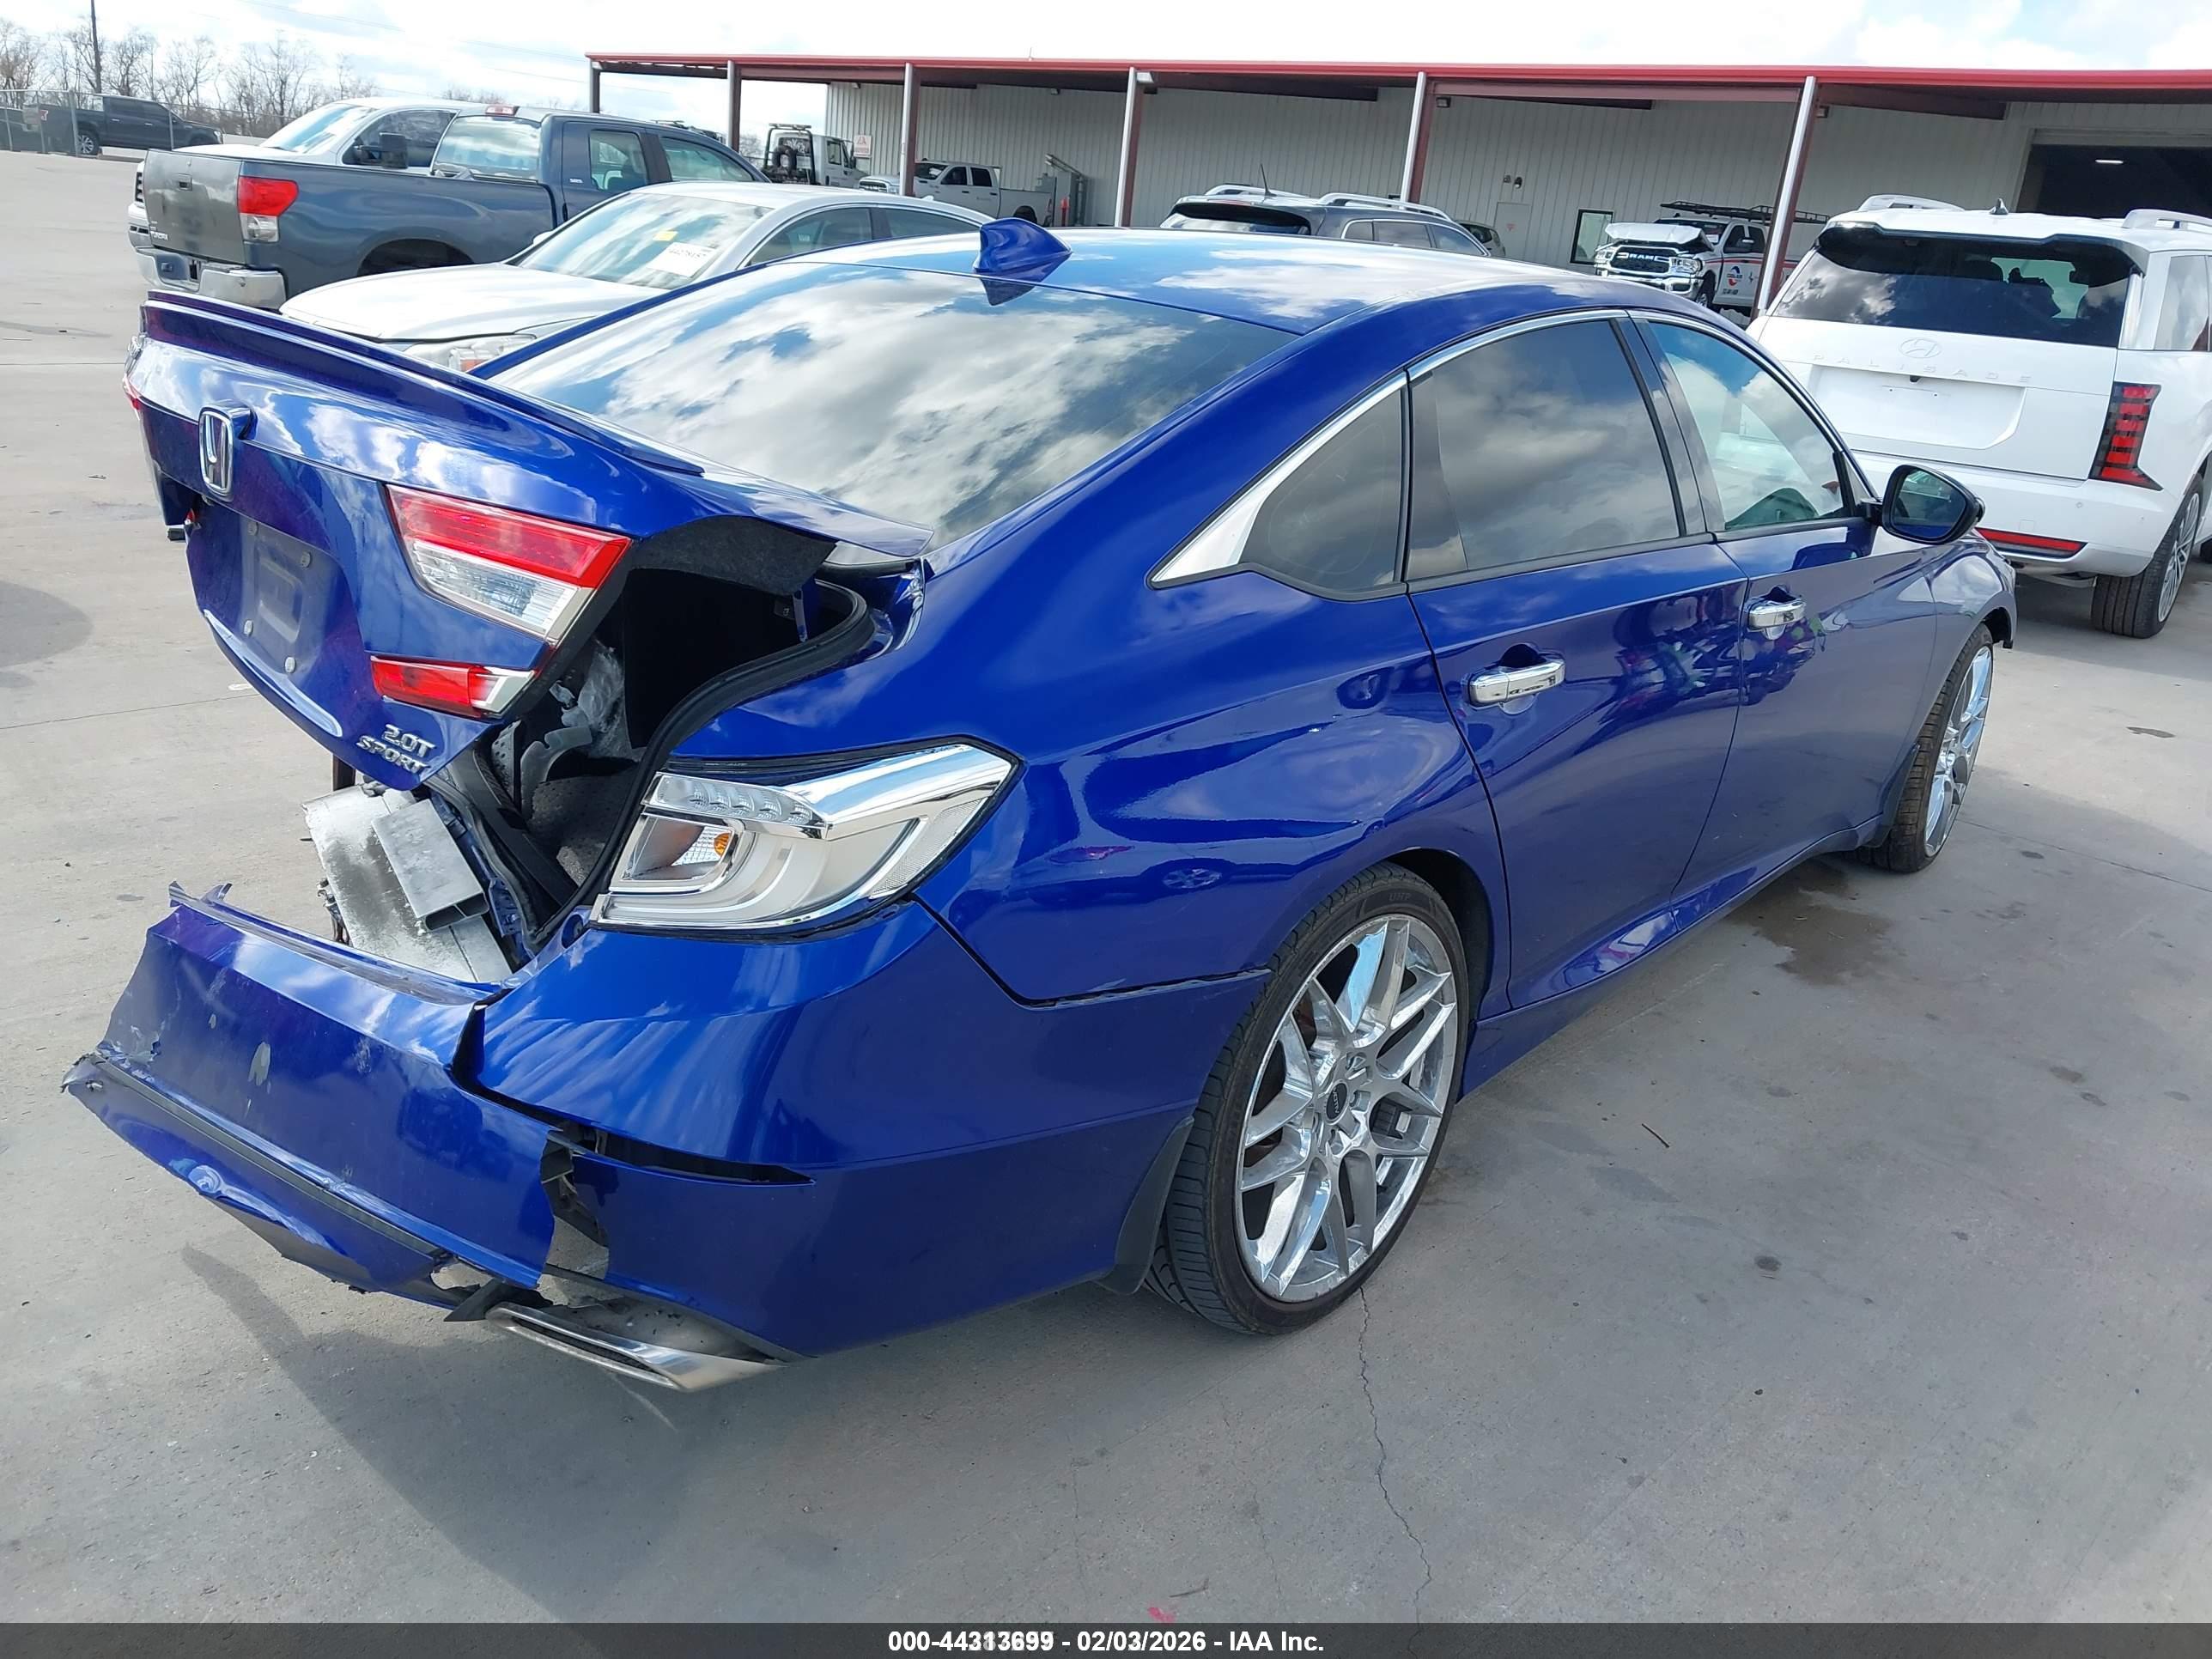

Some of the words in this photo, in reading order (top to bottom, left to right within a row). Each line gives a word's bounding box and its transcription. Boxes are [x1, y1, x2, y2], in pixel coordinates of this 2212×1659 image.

[1813, 353, 2032, 383] PALISADE
[356, 735, 431, 774] SPORT
[381, 723, 436, 757] 2.0T
